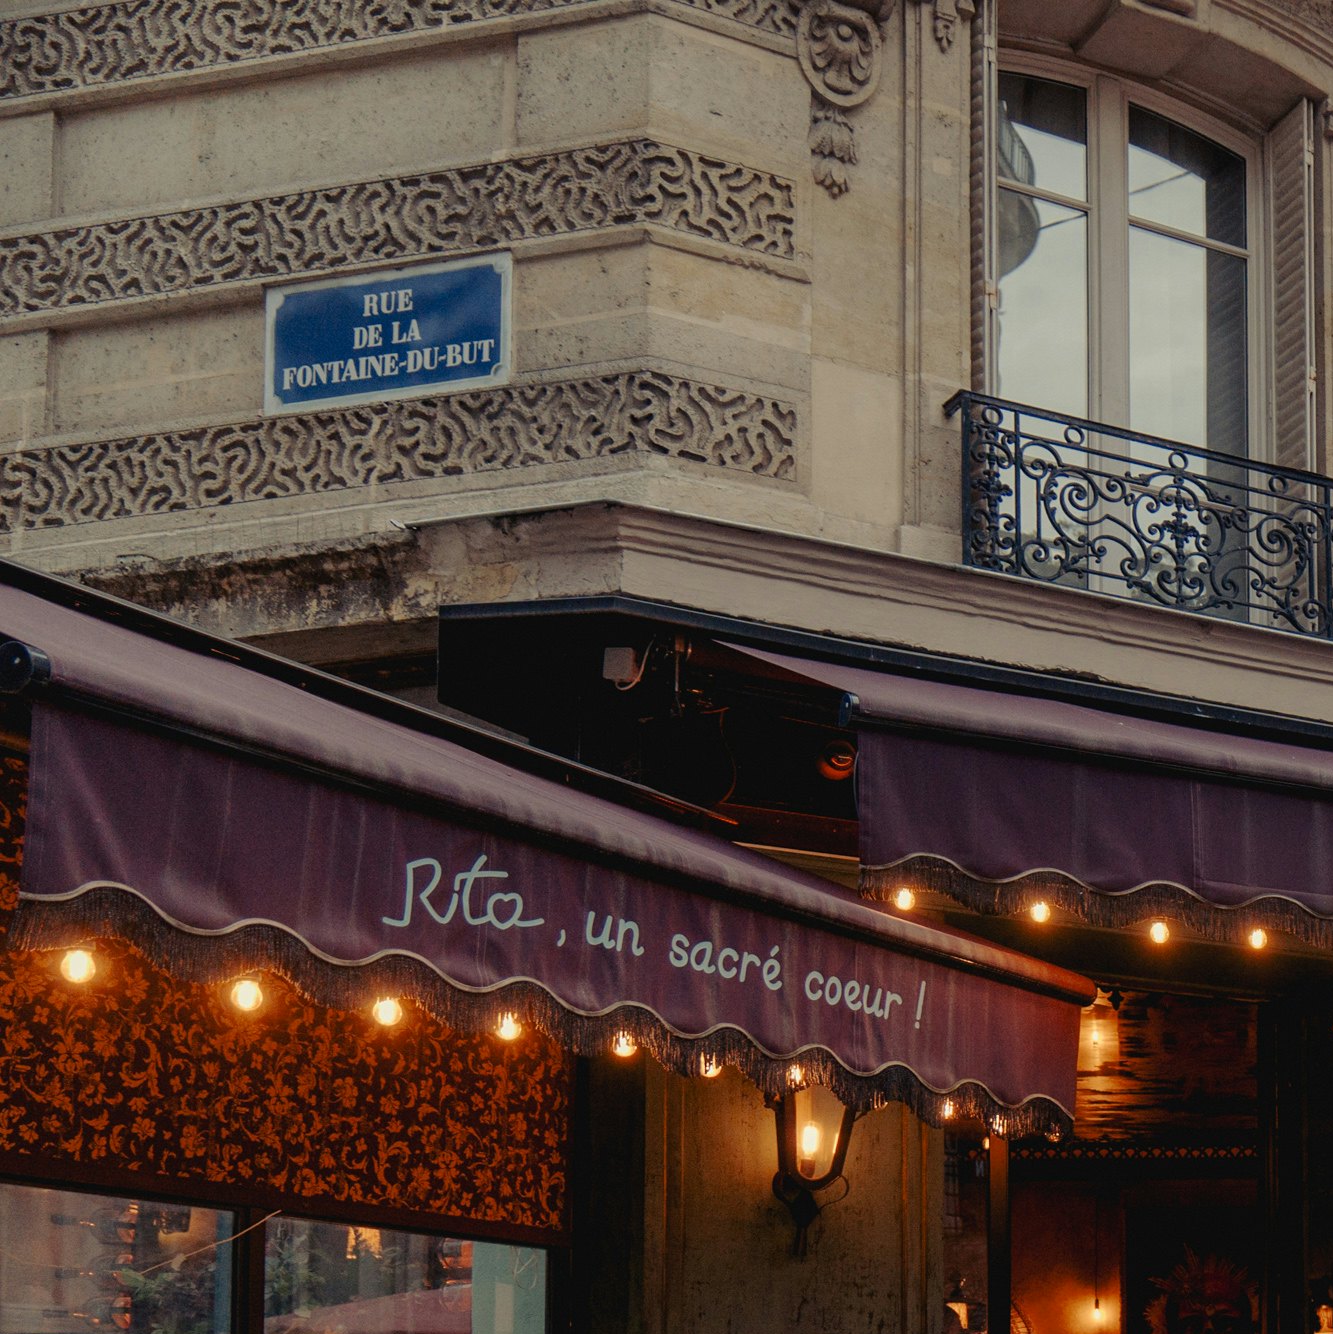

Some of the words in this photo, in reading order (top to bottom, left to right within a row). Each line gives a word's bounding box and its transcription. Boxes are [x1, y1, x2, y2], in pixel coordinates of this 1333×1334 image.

[363, 289, 413, 317] RUE
[353, 325, 382, 349] DE
[391, 319, 422, 344] LA
[282, 339, 495, 390] FONTAINE-DU-BUT
[585, 911, 645, 956] un
[669, 933, 783, 991] sacré
[804, 970, 903, 1019] coeur
